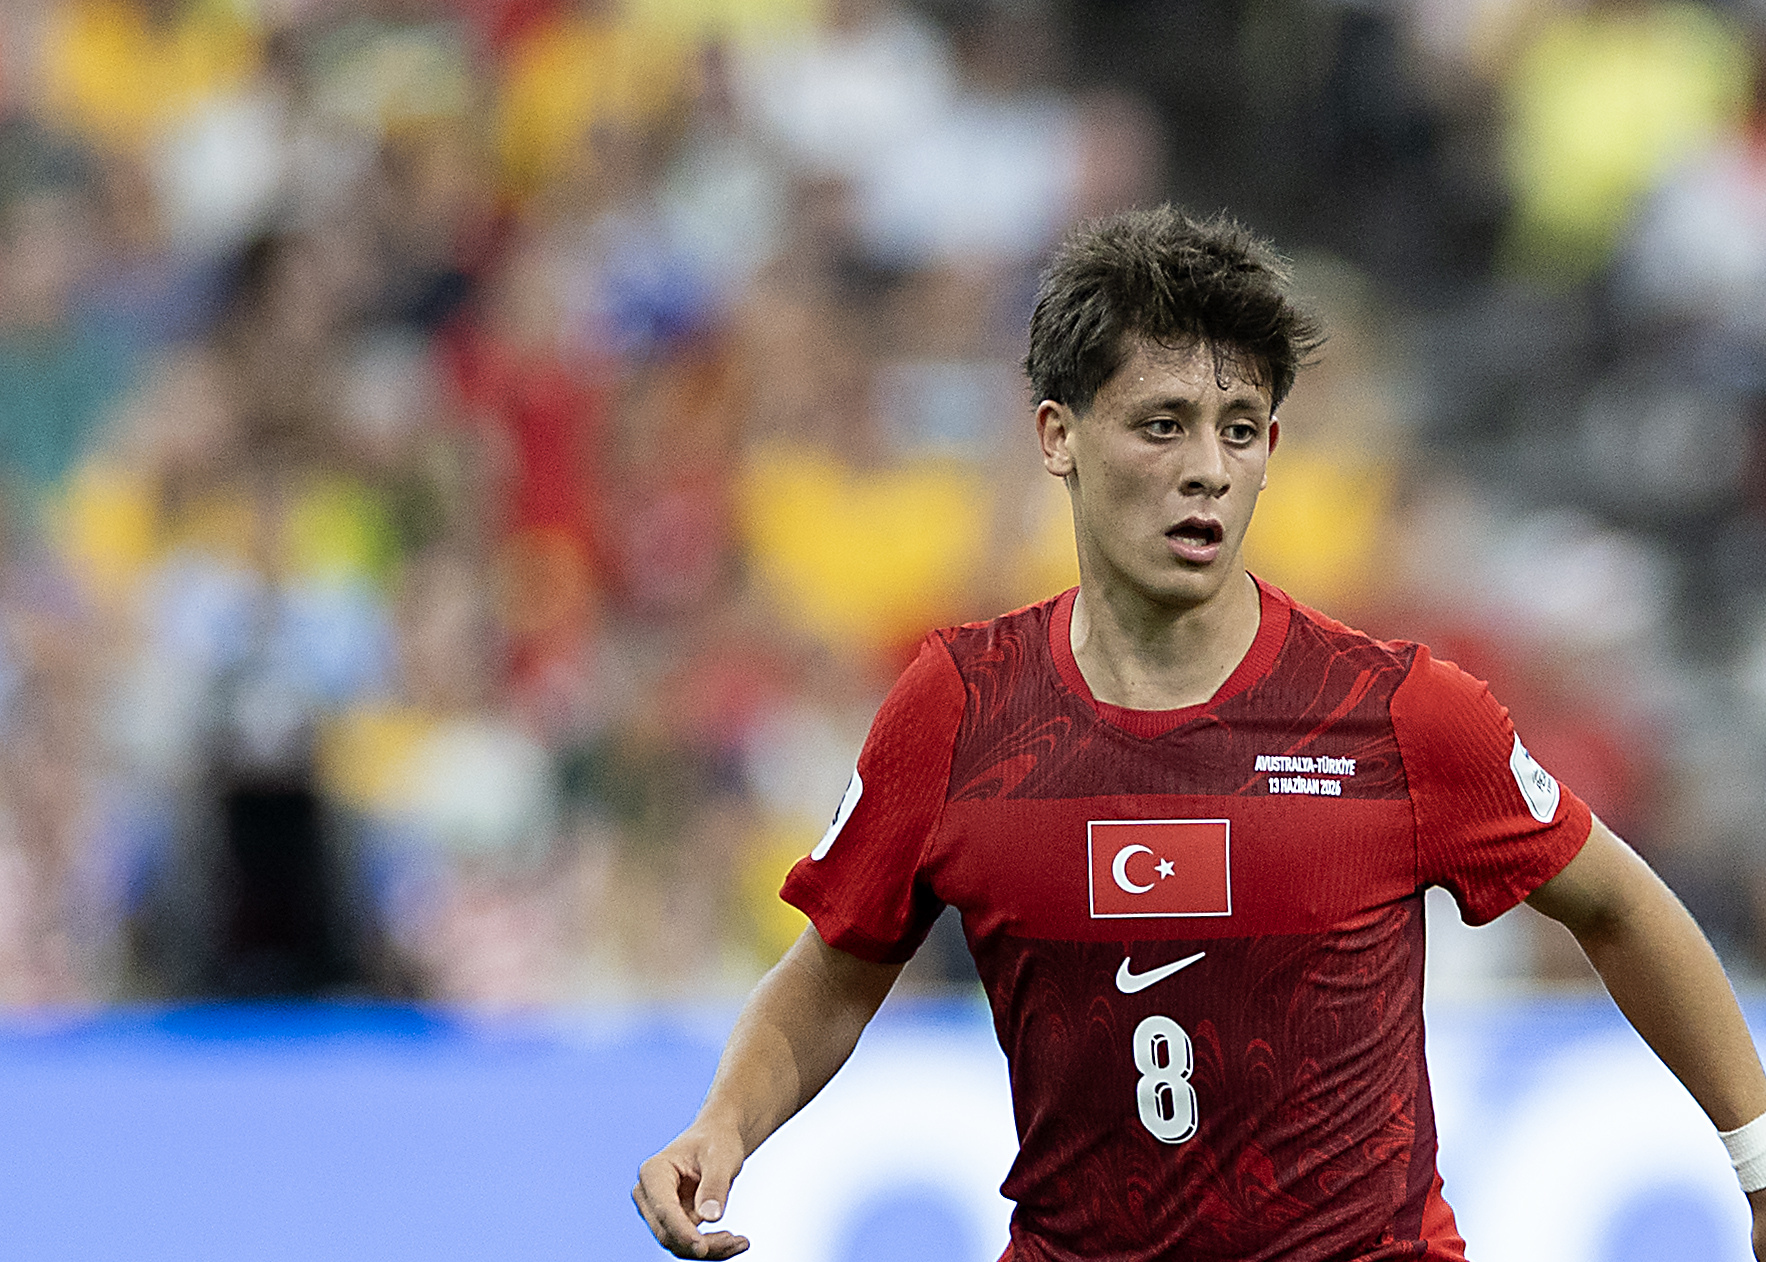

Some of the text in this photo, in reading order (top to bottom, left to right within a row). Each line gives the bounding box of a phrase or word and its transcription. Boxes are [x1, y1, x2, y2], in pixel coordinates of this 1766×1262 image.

[1268, 775, 1342, 796] 13 HAZİRAN 2026
[1133, 1015, 1198, 1144] 8
